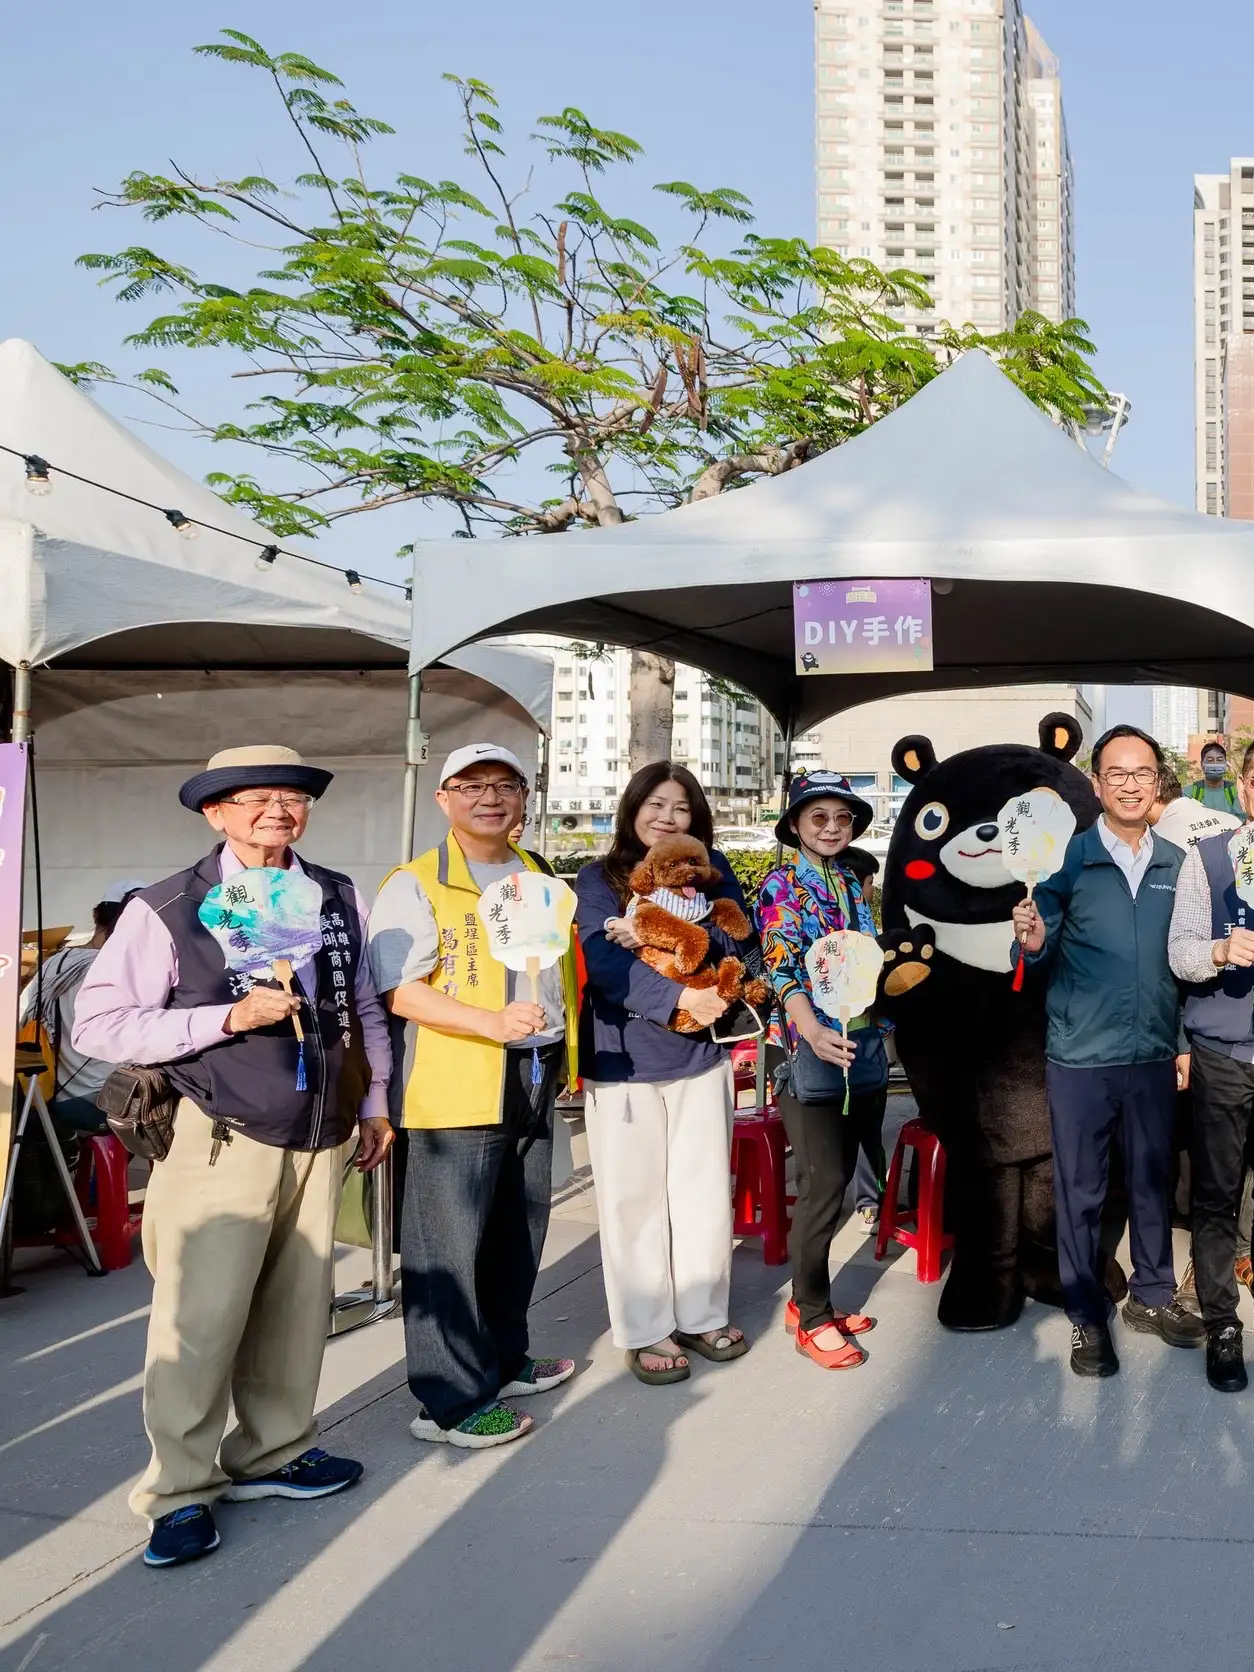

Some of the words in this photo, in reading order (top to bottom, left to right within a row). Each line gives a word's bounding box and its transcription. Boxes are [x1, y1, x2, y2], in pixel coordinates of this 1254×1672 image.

[804, 615, 923, 645] DIY手作
[1005, 801, 1032, 855] 觀光季
[1189, 818, 1220, 832] 立法委員
[217, 884, 255, 953] 觀光季
[330, 912, 352, 965] 高雄市
[489, 884, 522, 945] 觀光季
[464, 912, 480, 987] 鹽埕區主席
[813, 940, 841, 995] 觀光季
